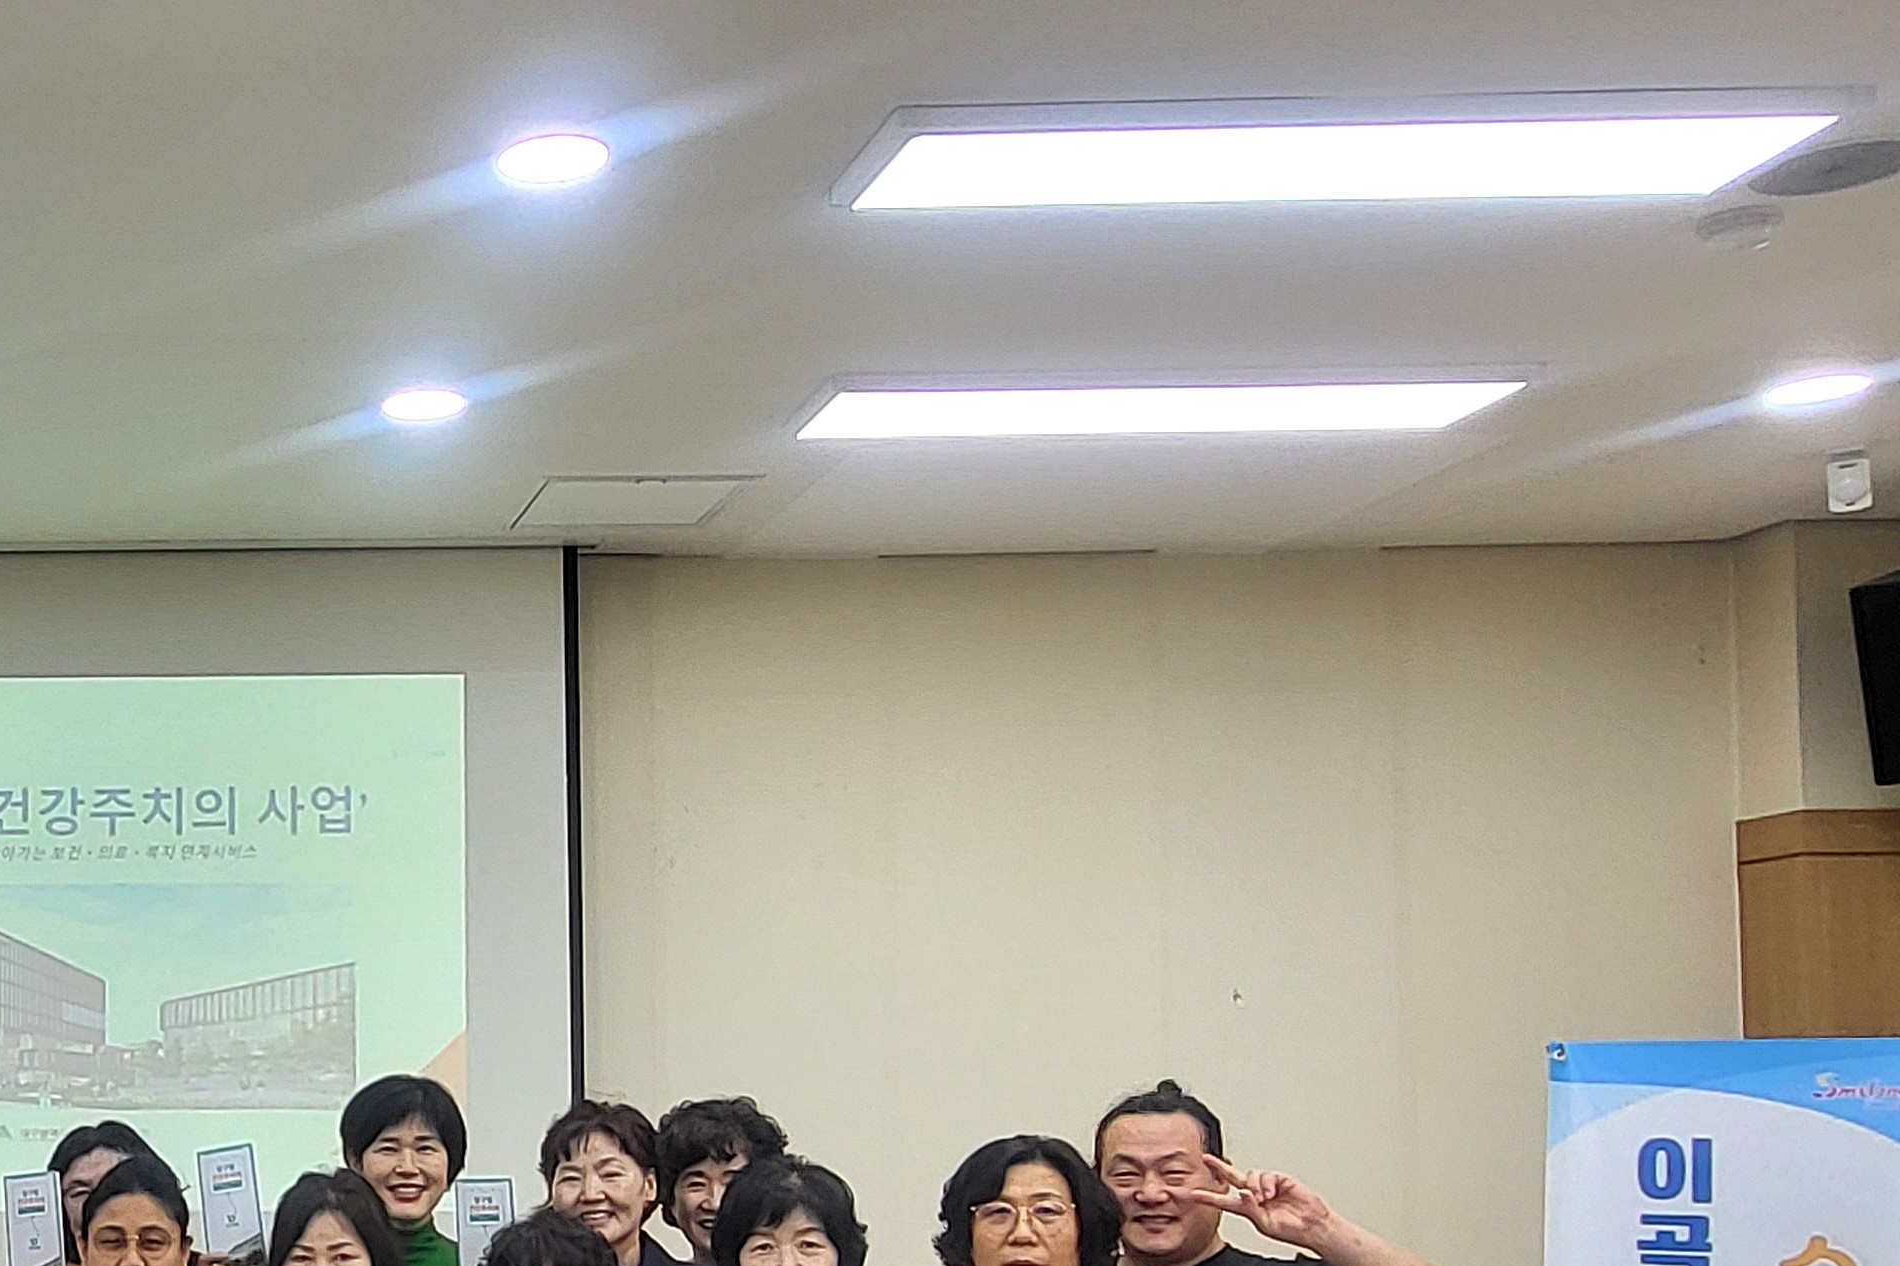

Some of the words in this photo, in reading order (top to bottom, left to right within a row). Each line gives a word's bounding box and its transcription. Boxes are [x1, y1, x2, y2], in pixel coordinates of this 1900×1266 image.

[50, 845, 82, 861] 보건
[97, 844, 129, 861] 의료
[145, 845, 177, 861] 복지
